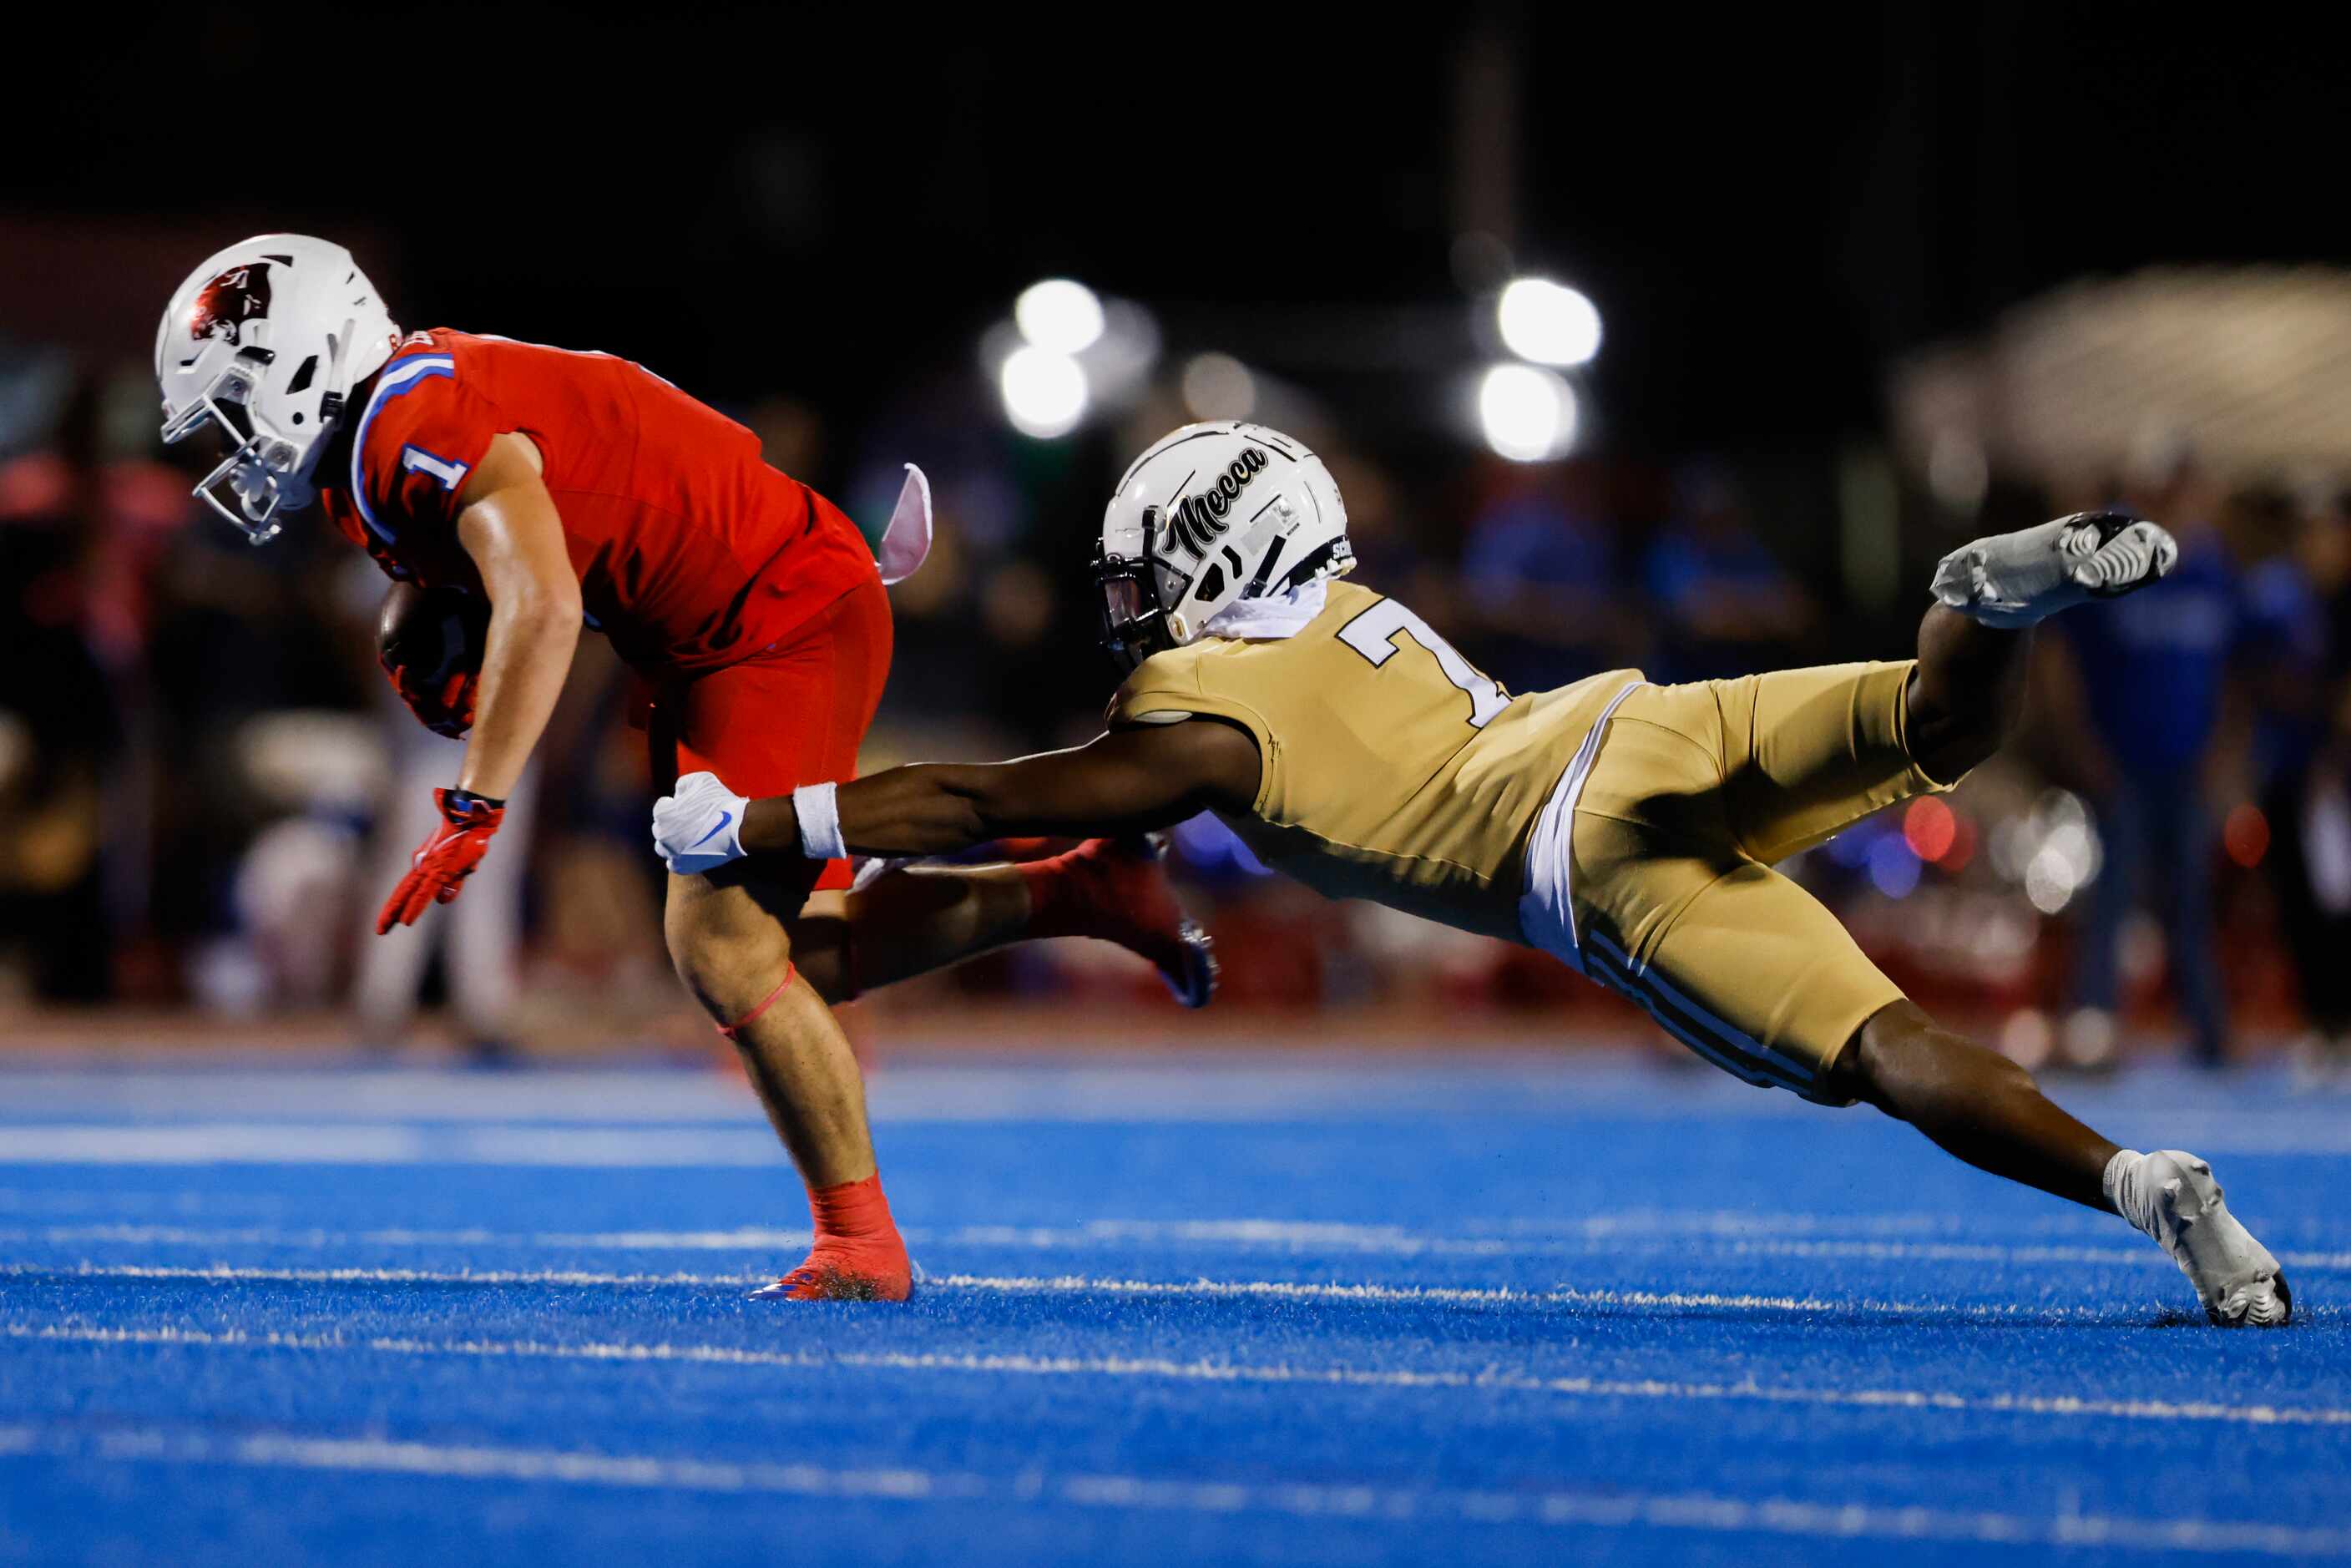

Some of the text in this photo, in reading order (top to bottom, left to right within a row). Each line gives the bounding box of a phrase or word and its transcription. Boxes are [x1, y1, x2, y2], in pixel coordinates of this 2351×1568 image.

[402, 443, 471, 494] 1
[1161, 448, 1268, 560] Mecca
[1334, 596, 1513, 729] 7
